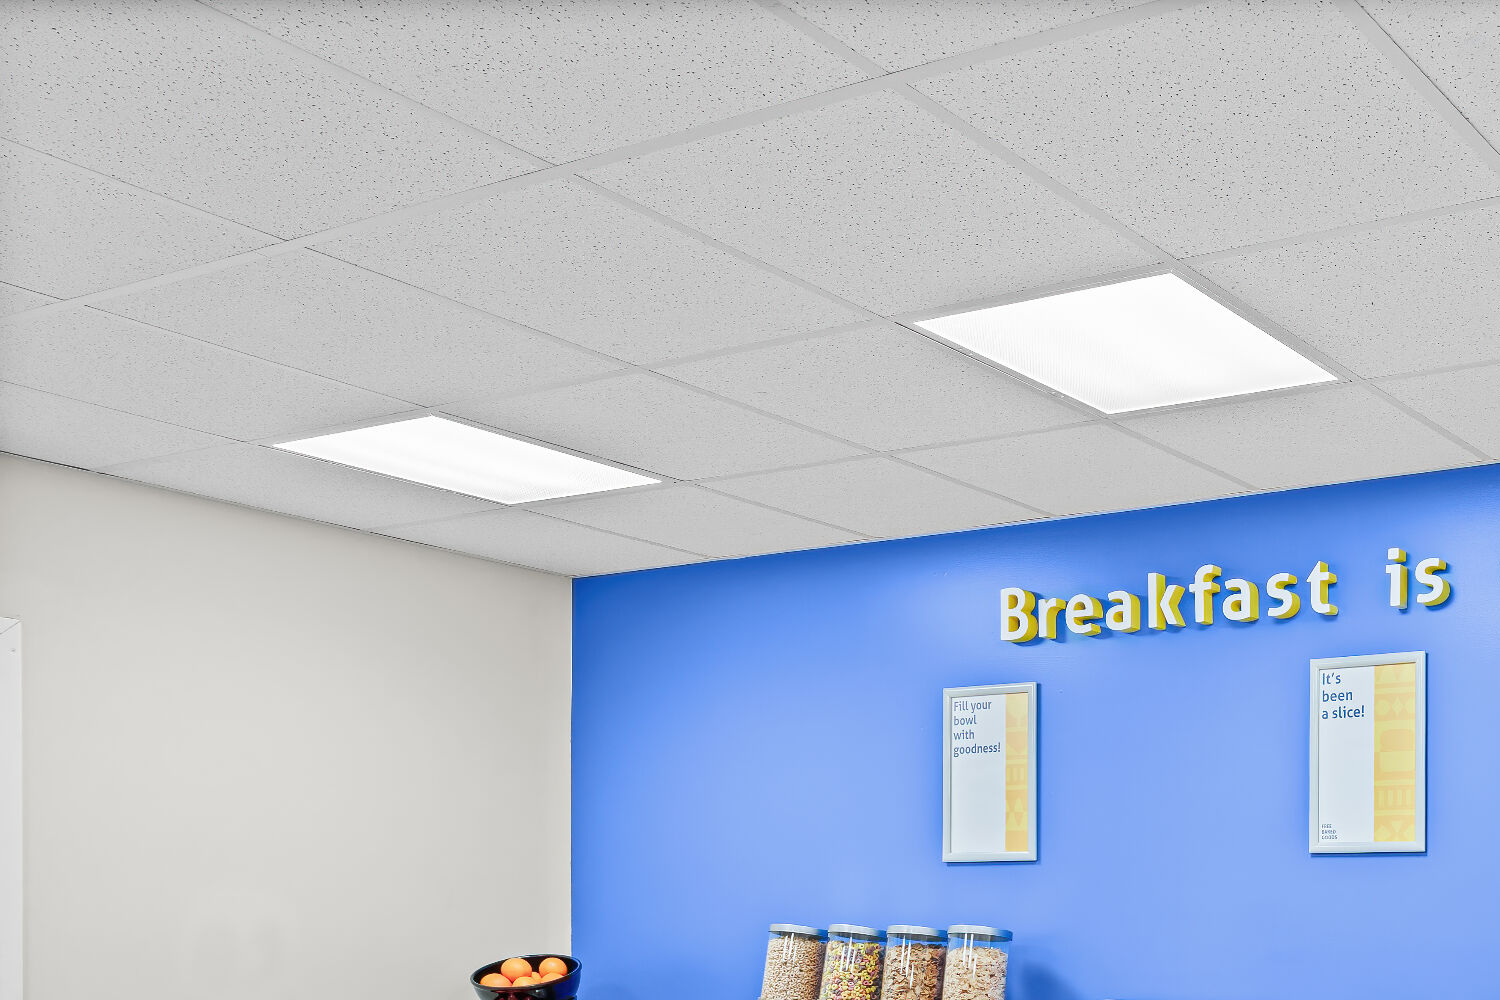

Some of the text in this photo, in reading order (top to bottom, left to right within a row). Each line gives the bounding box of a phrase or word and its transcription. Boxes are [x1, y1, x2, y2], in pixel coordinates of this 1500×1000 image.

[1000, 560, 1339, 643] Breakfast
[1385, 547, 1451, 609] is
[1322, 672, 1341, 685] It's
[1322, 689, 1353, 702] been
[953, 701, 992, 714] Fill your
[1321, 704, 1365, 720] a slice!
[953, 714, 977, 726] bowl
[953, 729, 975, 740] with
[953, 742, 1001, 758] goodness!
